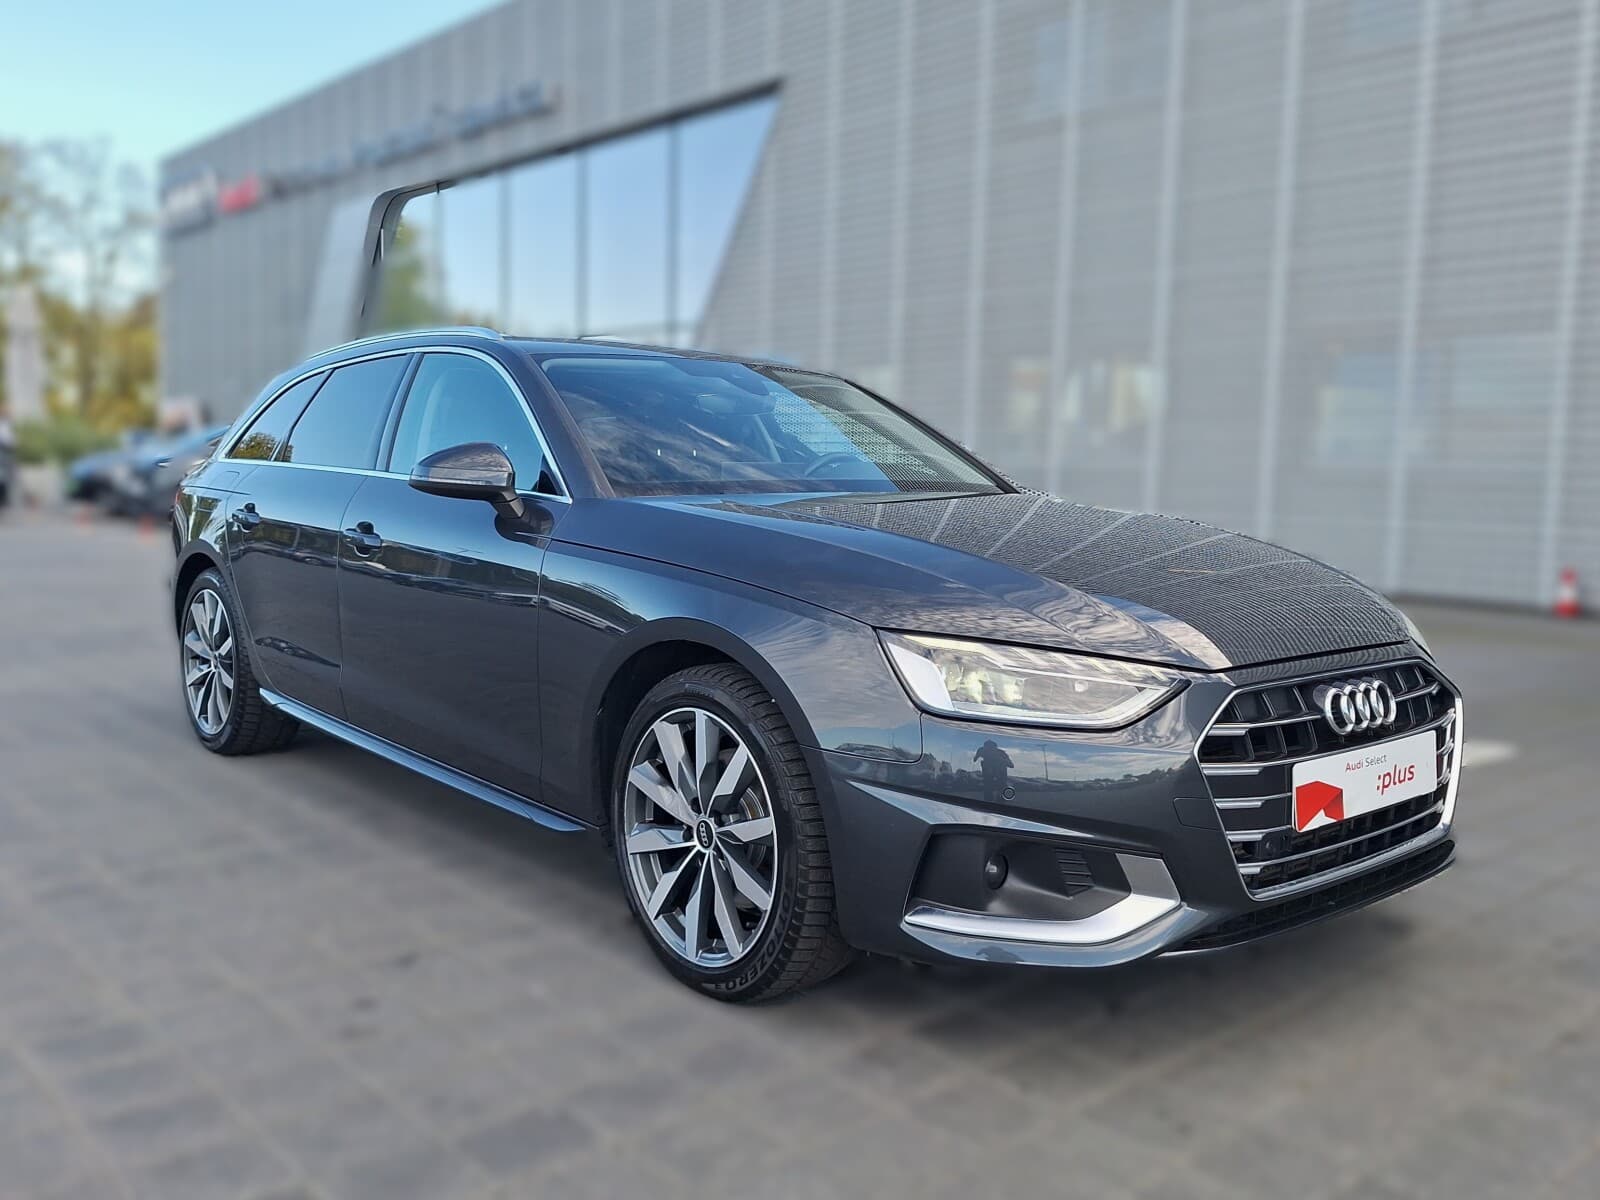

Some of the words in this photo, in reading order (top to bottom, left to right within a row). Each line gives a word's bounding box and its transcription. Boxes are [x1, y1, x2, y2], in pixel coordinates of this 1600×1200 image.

[1345, 760, 1364, 773] Audi
[1365, 754, 1387, 767] Select
[1376, 764, 1415, 796] :plus
